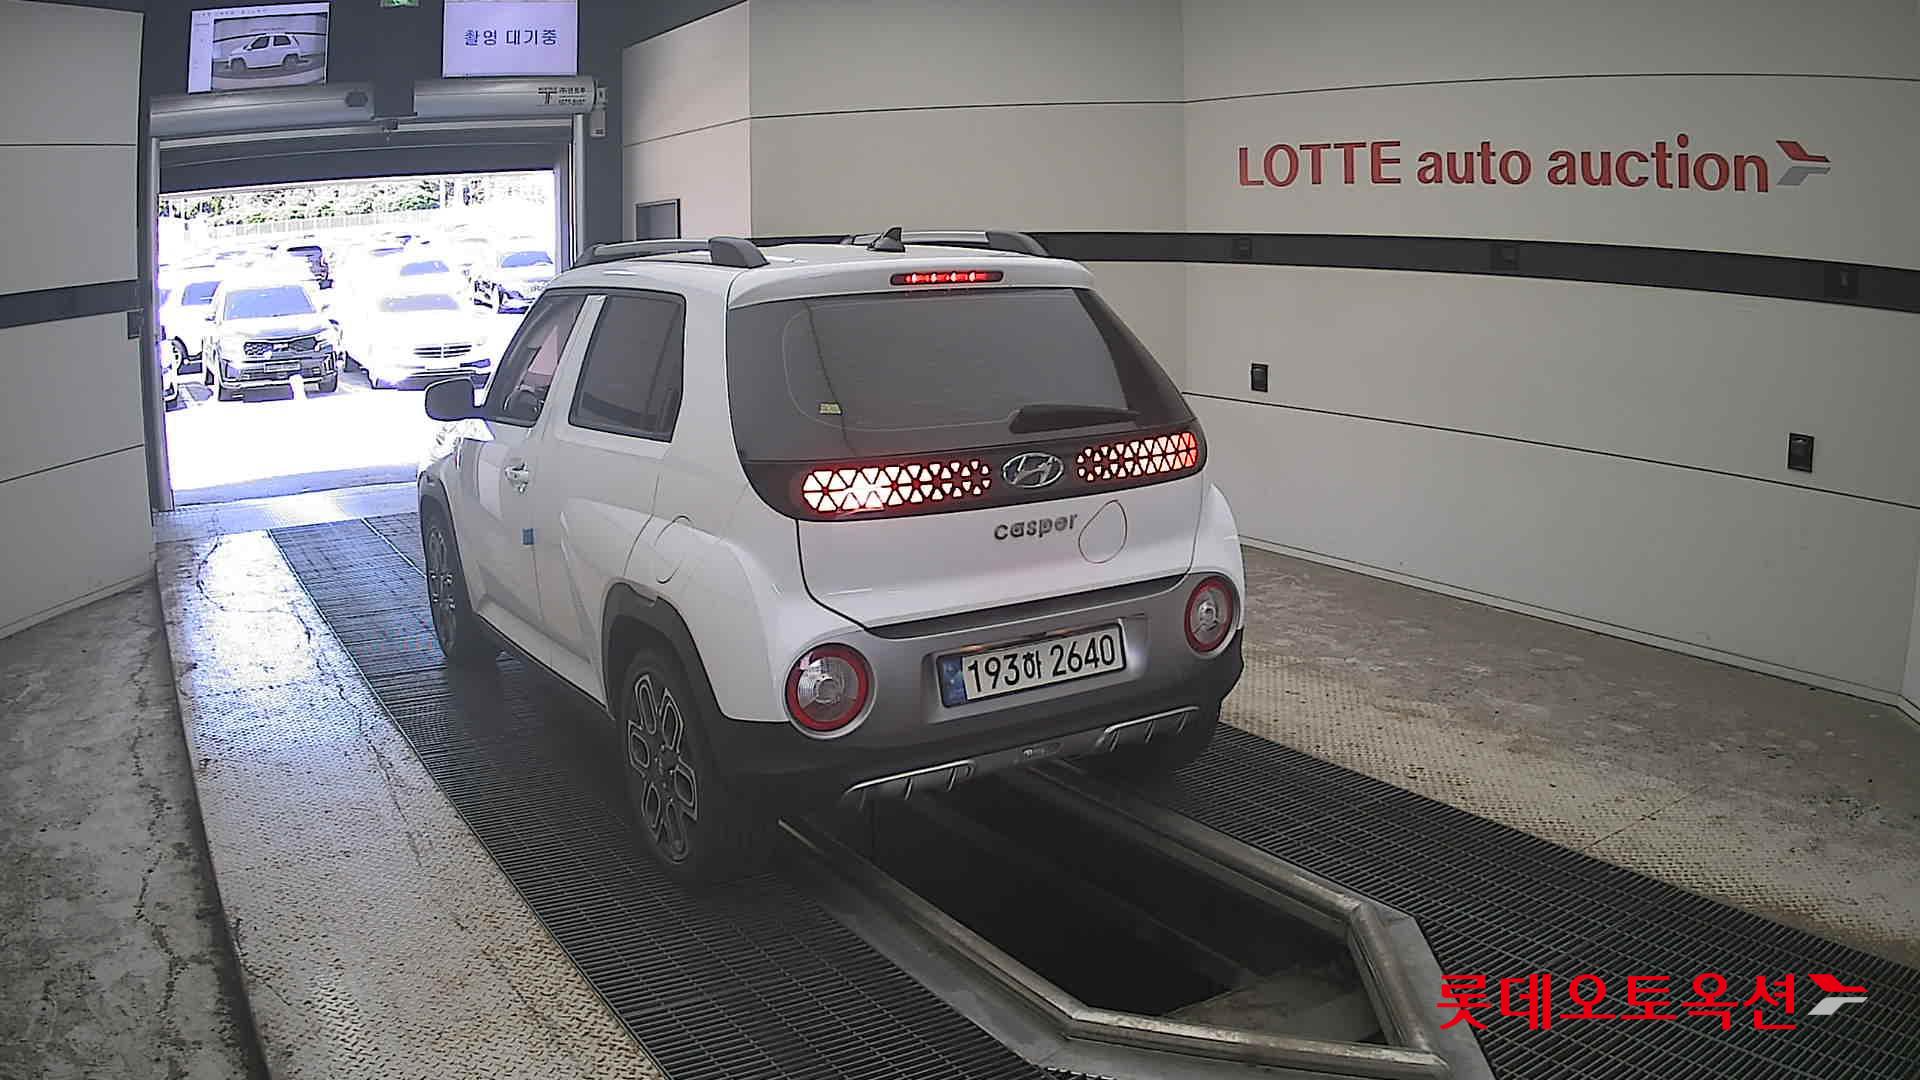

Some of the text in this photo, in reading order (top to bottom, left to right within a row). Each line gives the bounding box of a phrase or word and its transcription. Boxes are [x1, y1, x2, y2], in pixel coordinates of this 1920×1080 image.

[505, 29, 557, 46] 대기중
[1240, 133, 1769, 192] LOTTE auto auction
[994, 514, 1078, 540] casper
[968, 650, 1042, 692] 193하
[1050, 635, 1116, 677] 2640
